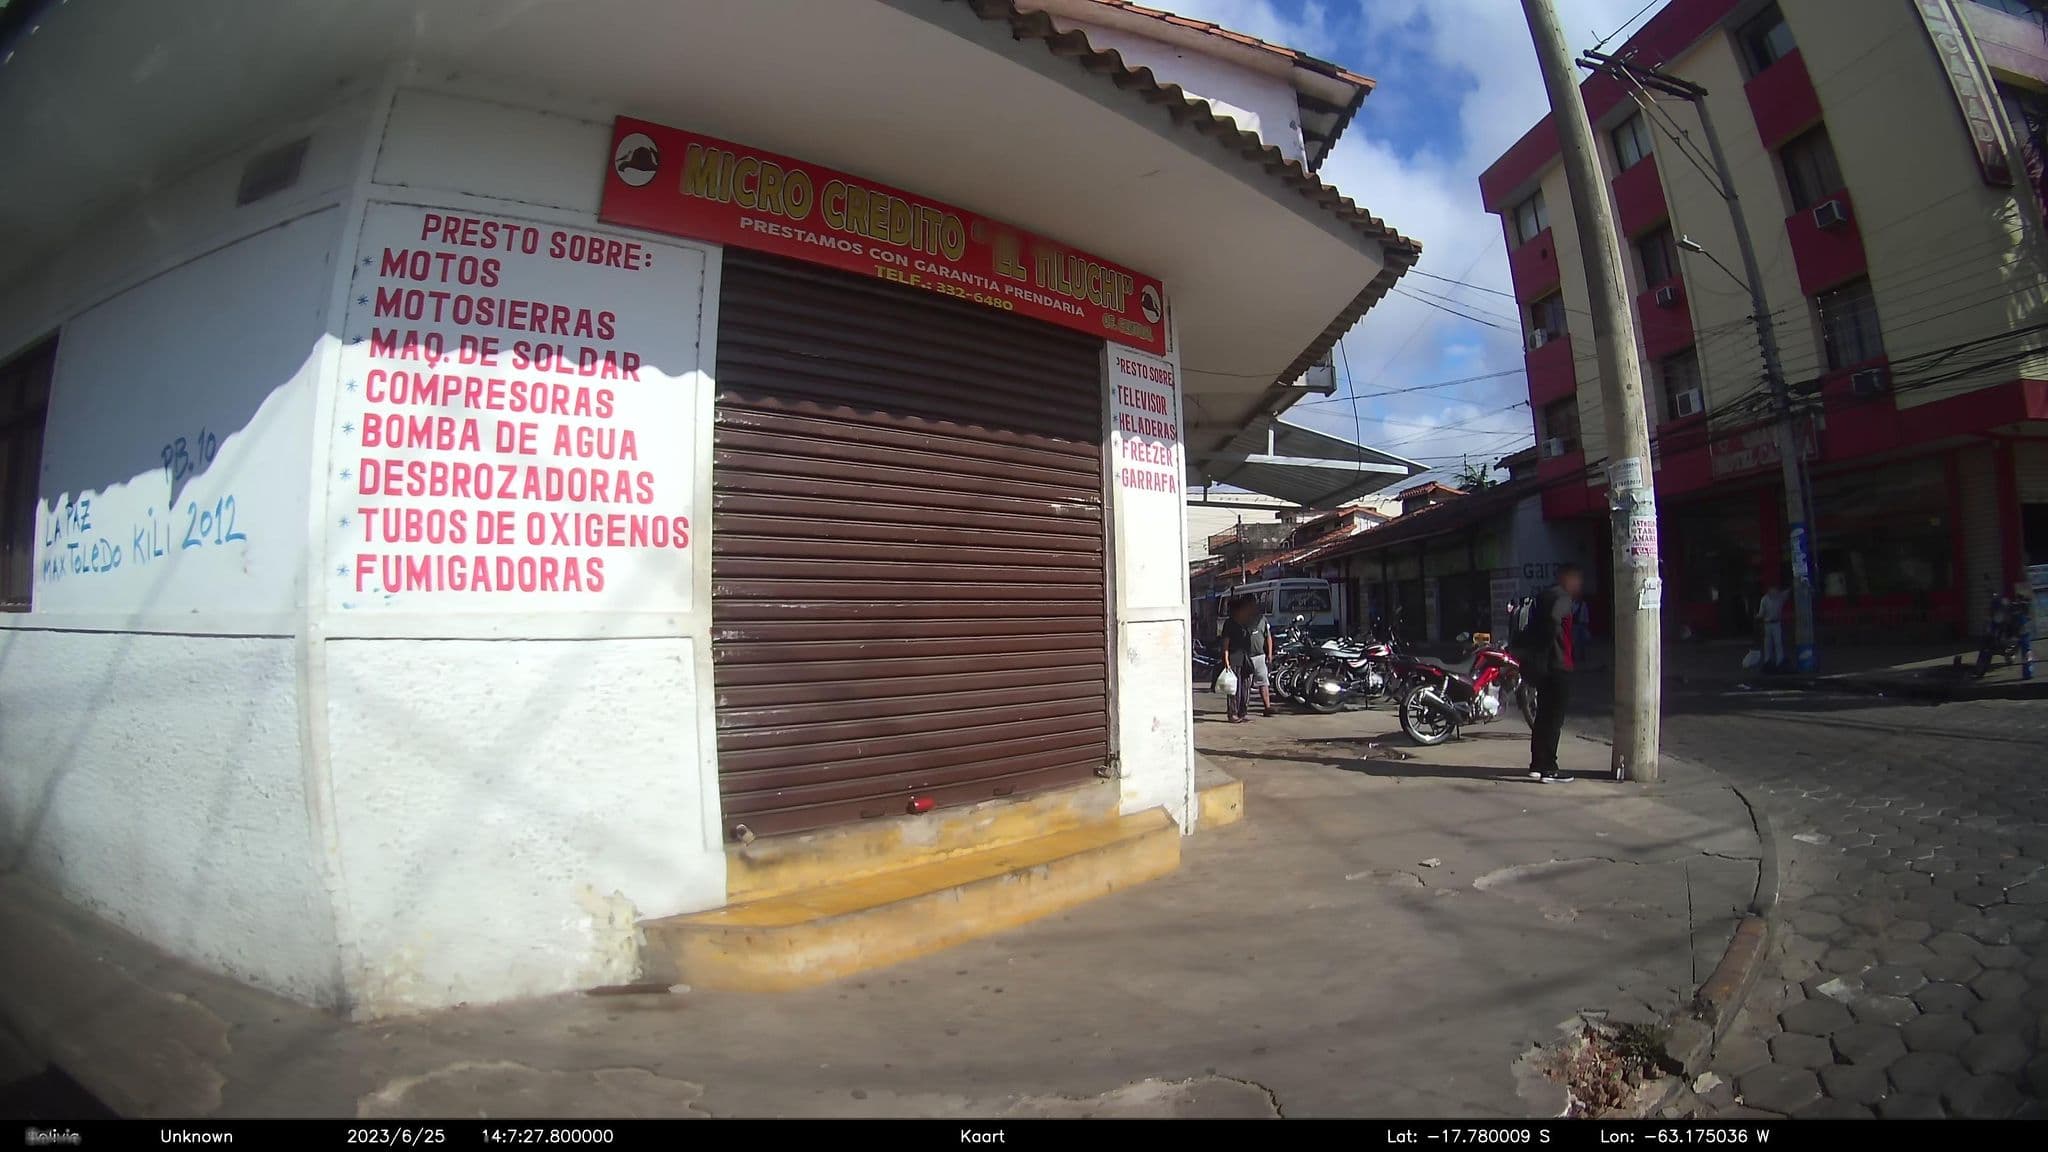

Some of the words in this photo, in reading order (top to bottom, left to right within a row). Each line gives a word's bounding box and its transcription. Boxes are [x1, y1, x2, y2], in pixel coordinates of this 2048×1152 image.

[681, 143, 814, 220] MICRO
[821, 179, 966, 261] CREDITO
[421, 214, 539, 255] PRESTO
[549, 231, 652, 271] SOBRE:
[379, 247, 501, 288] MOTOS
[740, 216, 863, 255] PRESTAMOS
[869, 248, 908, 267] CON
[914, 260, 1000, 292] GARANTIA
[1004, 284, 1085, 317] PRENDARIA
[374, 286, 616, 340] MOTOSIERRAS
[936, 282, 1014, 311] 332-6480
[369, 327, 449, 370] MAQ.
[458, 335, 500, 367] DE
[512, 340, 641, 382] SOLDAR
[366, 369, 615, 419] COMPRESORAS
[1117, 384, 1167, 416] TELEVISOR
[361, 412, 481, 452] BOMBA
[495, 420, 538, 455] DE
[553, 424, 639, 461] AGUA
[1119, 412, 1176, 440] HELADERAS
[1122, 439, 1173, 467] FREEZER
[358, 458, 655, 504] DESBROZADORAS
[1121, 467, 1176, 494] GARRAFA
[182, 494, 248, 549] 2012
[357, 507, 467, 544] TUBOS
[476, 510, 515, 545] DE
[527, 512, 690, 549] OXIGENOS
[356, 553, 605, 593] FUMIGADORAS
